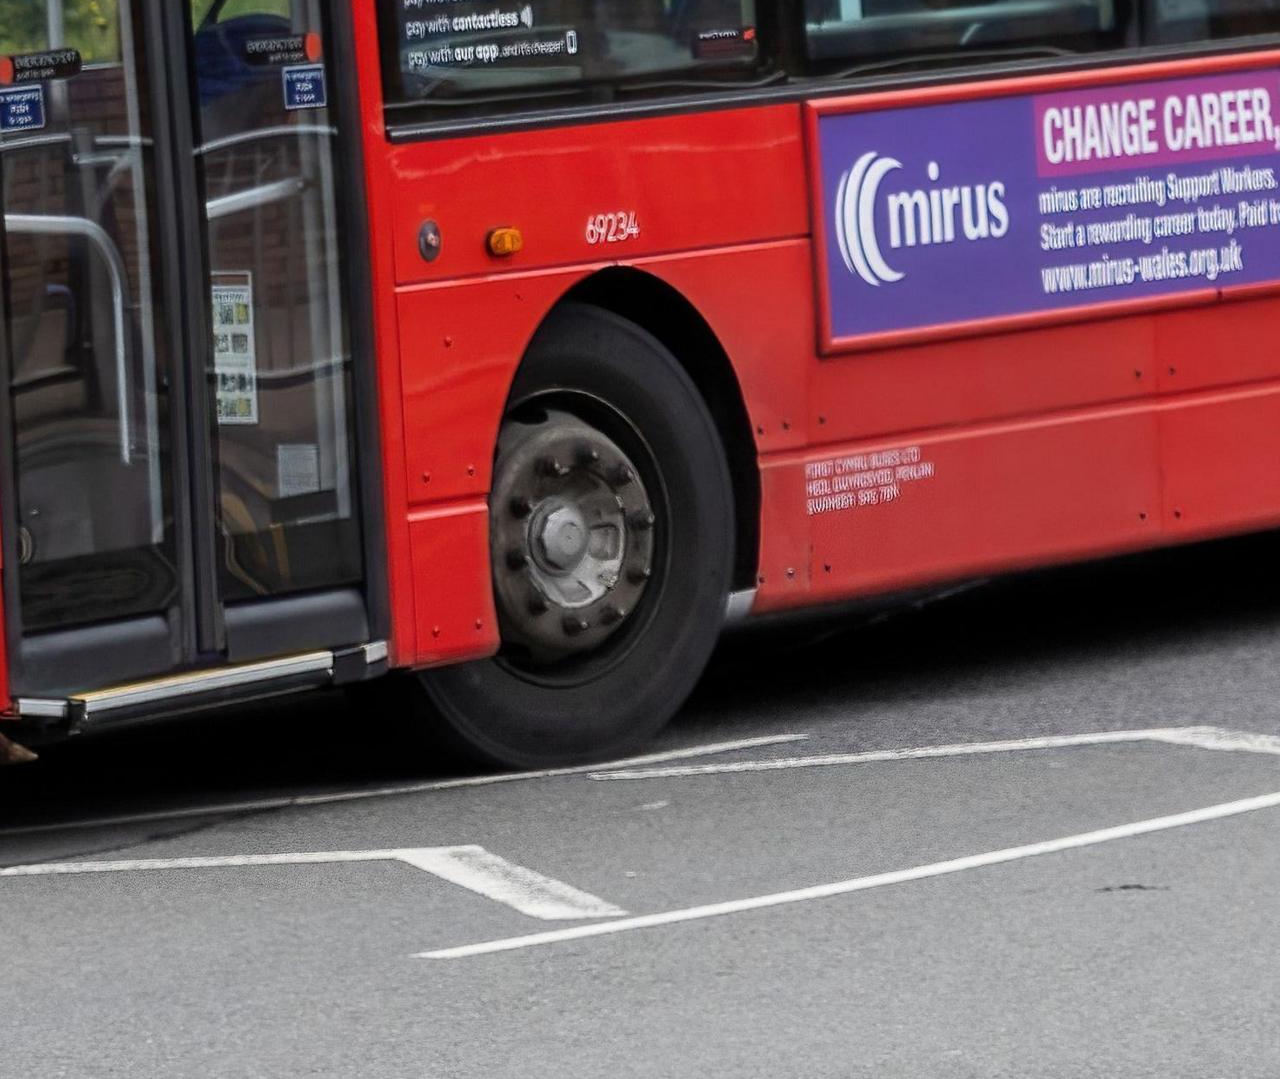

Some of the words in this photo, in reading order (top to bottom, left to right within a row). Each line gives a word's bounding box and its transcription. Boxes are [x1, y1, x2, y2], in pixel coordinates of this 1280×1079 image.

[406, 20, 425, 38] pay
[428, 15, 451, 34] with
[452, 9, 519, 31] contactless
[408, 50, 428, 69] pay
[430, 46, 454, 64] with
[455, 46, 474, 62] our
[1043, 98, 1159, 164] CHANGE
[887, 161, 1009, 249] mirus
[1039, 185, 1079, 214] mirus
[1080, 187, 1102, 210] are
[1103, 176, 1166, 207] recruiting
[1167, 169, 1219, 203] Support
[1220, 165, 1278, 193] Workers.
[586, 211, 640, 245] 69234
[1040, 221, 1075, 250] Start
[1076, 225, 1086, 247] a
[1087, 213, 1152, 245] rewarding
[1154, 213, 1195, 239] career
[1197, 205, 1239, 234] today.
[1239, 199, 1269, 227] Paid
[1041, 238, 1244, 293] www.mirus-wales.org.uk
